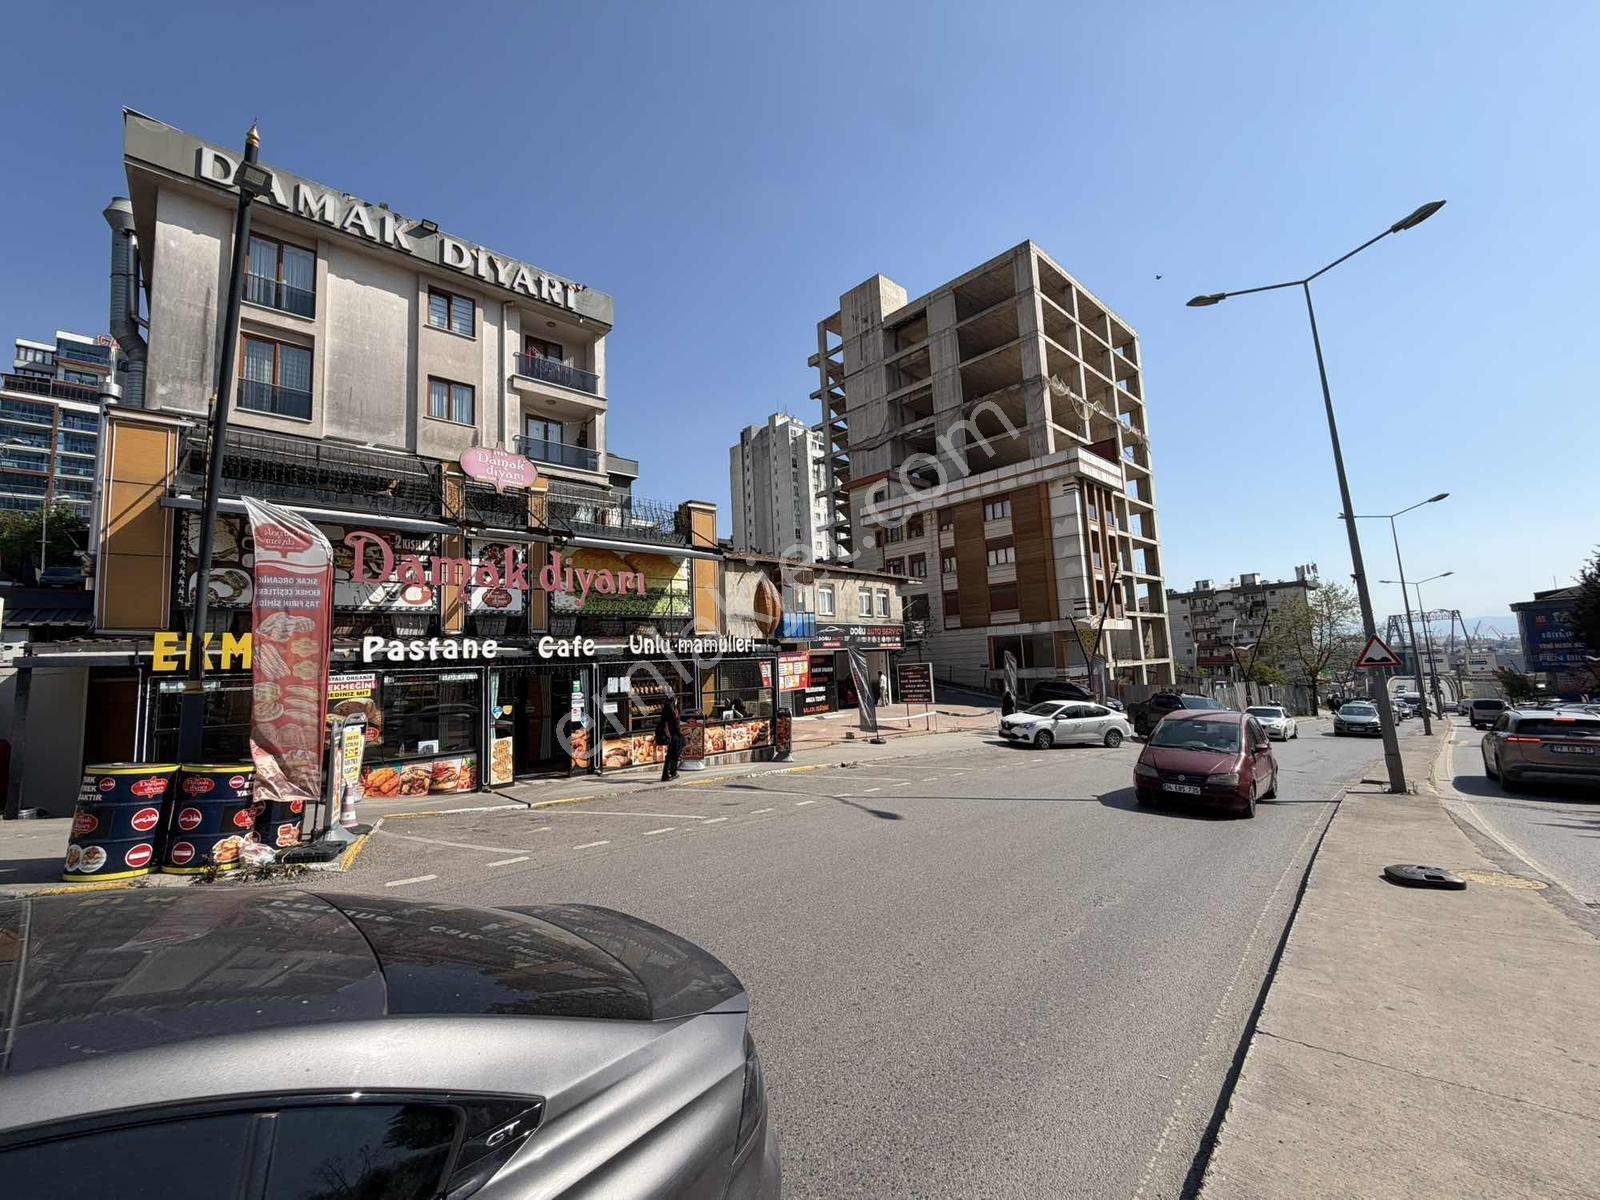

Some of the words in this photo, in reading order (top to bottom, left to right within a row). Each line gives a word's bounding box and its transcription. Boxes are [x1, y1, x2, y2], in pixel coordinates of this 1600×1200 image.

[476, 450, 526, 471] Damak
[343, 531, 531, 604] Damak
[539, 550, 647, 608] diyarı
[363, 635, 498, 663] Pastane
[537, 635, 596, 659] Cafe
[485, 1120, 520, 1147] GT
